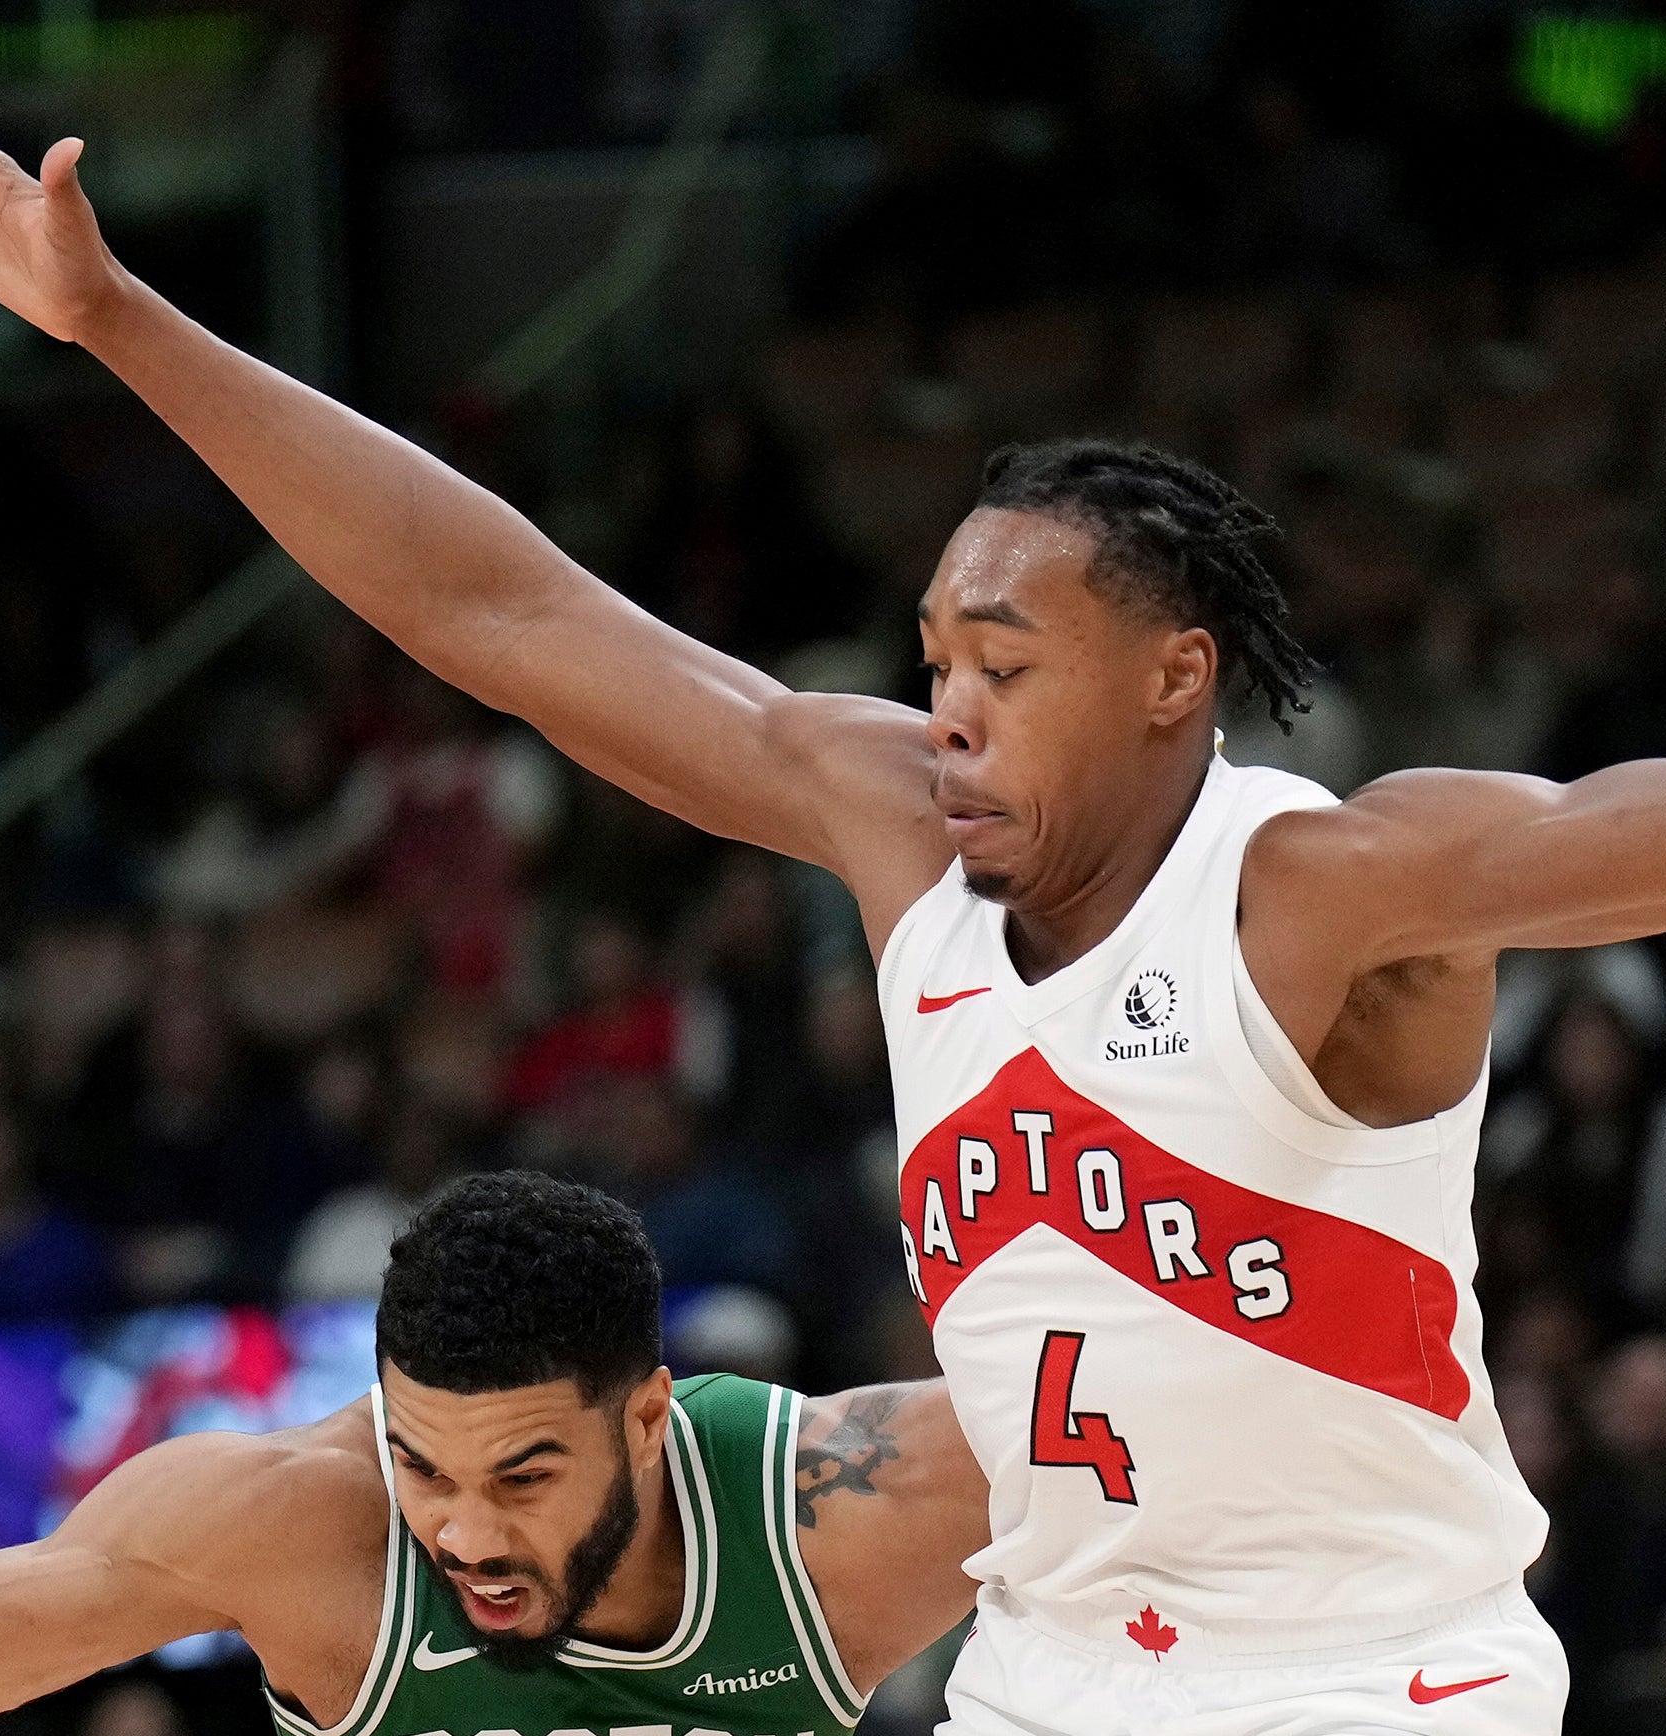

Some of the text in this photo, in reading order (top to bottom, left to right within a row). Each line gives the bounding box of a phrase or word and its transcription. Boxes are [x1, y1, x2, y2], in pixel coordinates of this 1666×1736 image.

[1105, 1032, 1190, 1062] Sun Life
[899, 1109, 1294, 1322] RAPTORS
[1030, 1329, 1139, 1507] 4
[682, 1662, 799, 1696] Amica
